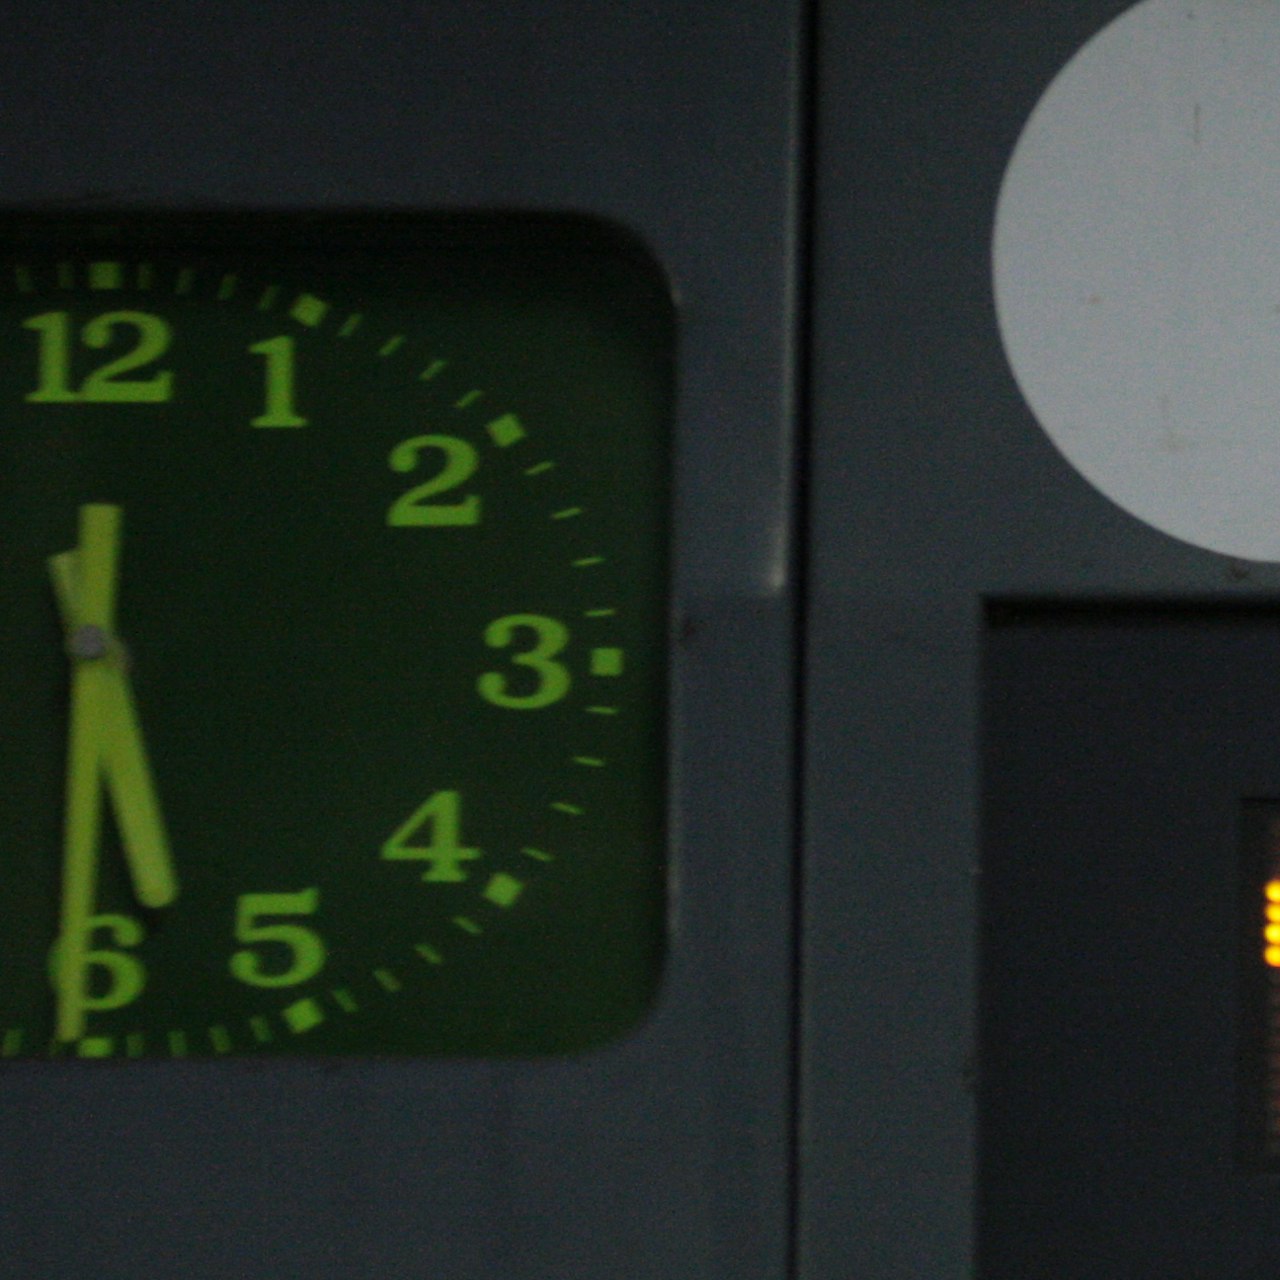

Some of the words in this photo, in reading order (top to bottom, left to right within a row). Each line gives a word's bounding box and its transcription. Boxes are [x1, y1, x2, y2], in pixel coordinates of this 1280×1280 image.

[22, 310, 174, 403] 12
[248, 334, 308, 428] 1
[386, 434, 481, 527] 2
[478, 613, 572, 709] 3
[380, 790, 481, 883] 4
[48, 914, 146, 1012] 6
[230, 887, 327, 988] 5
